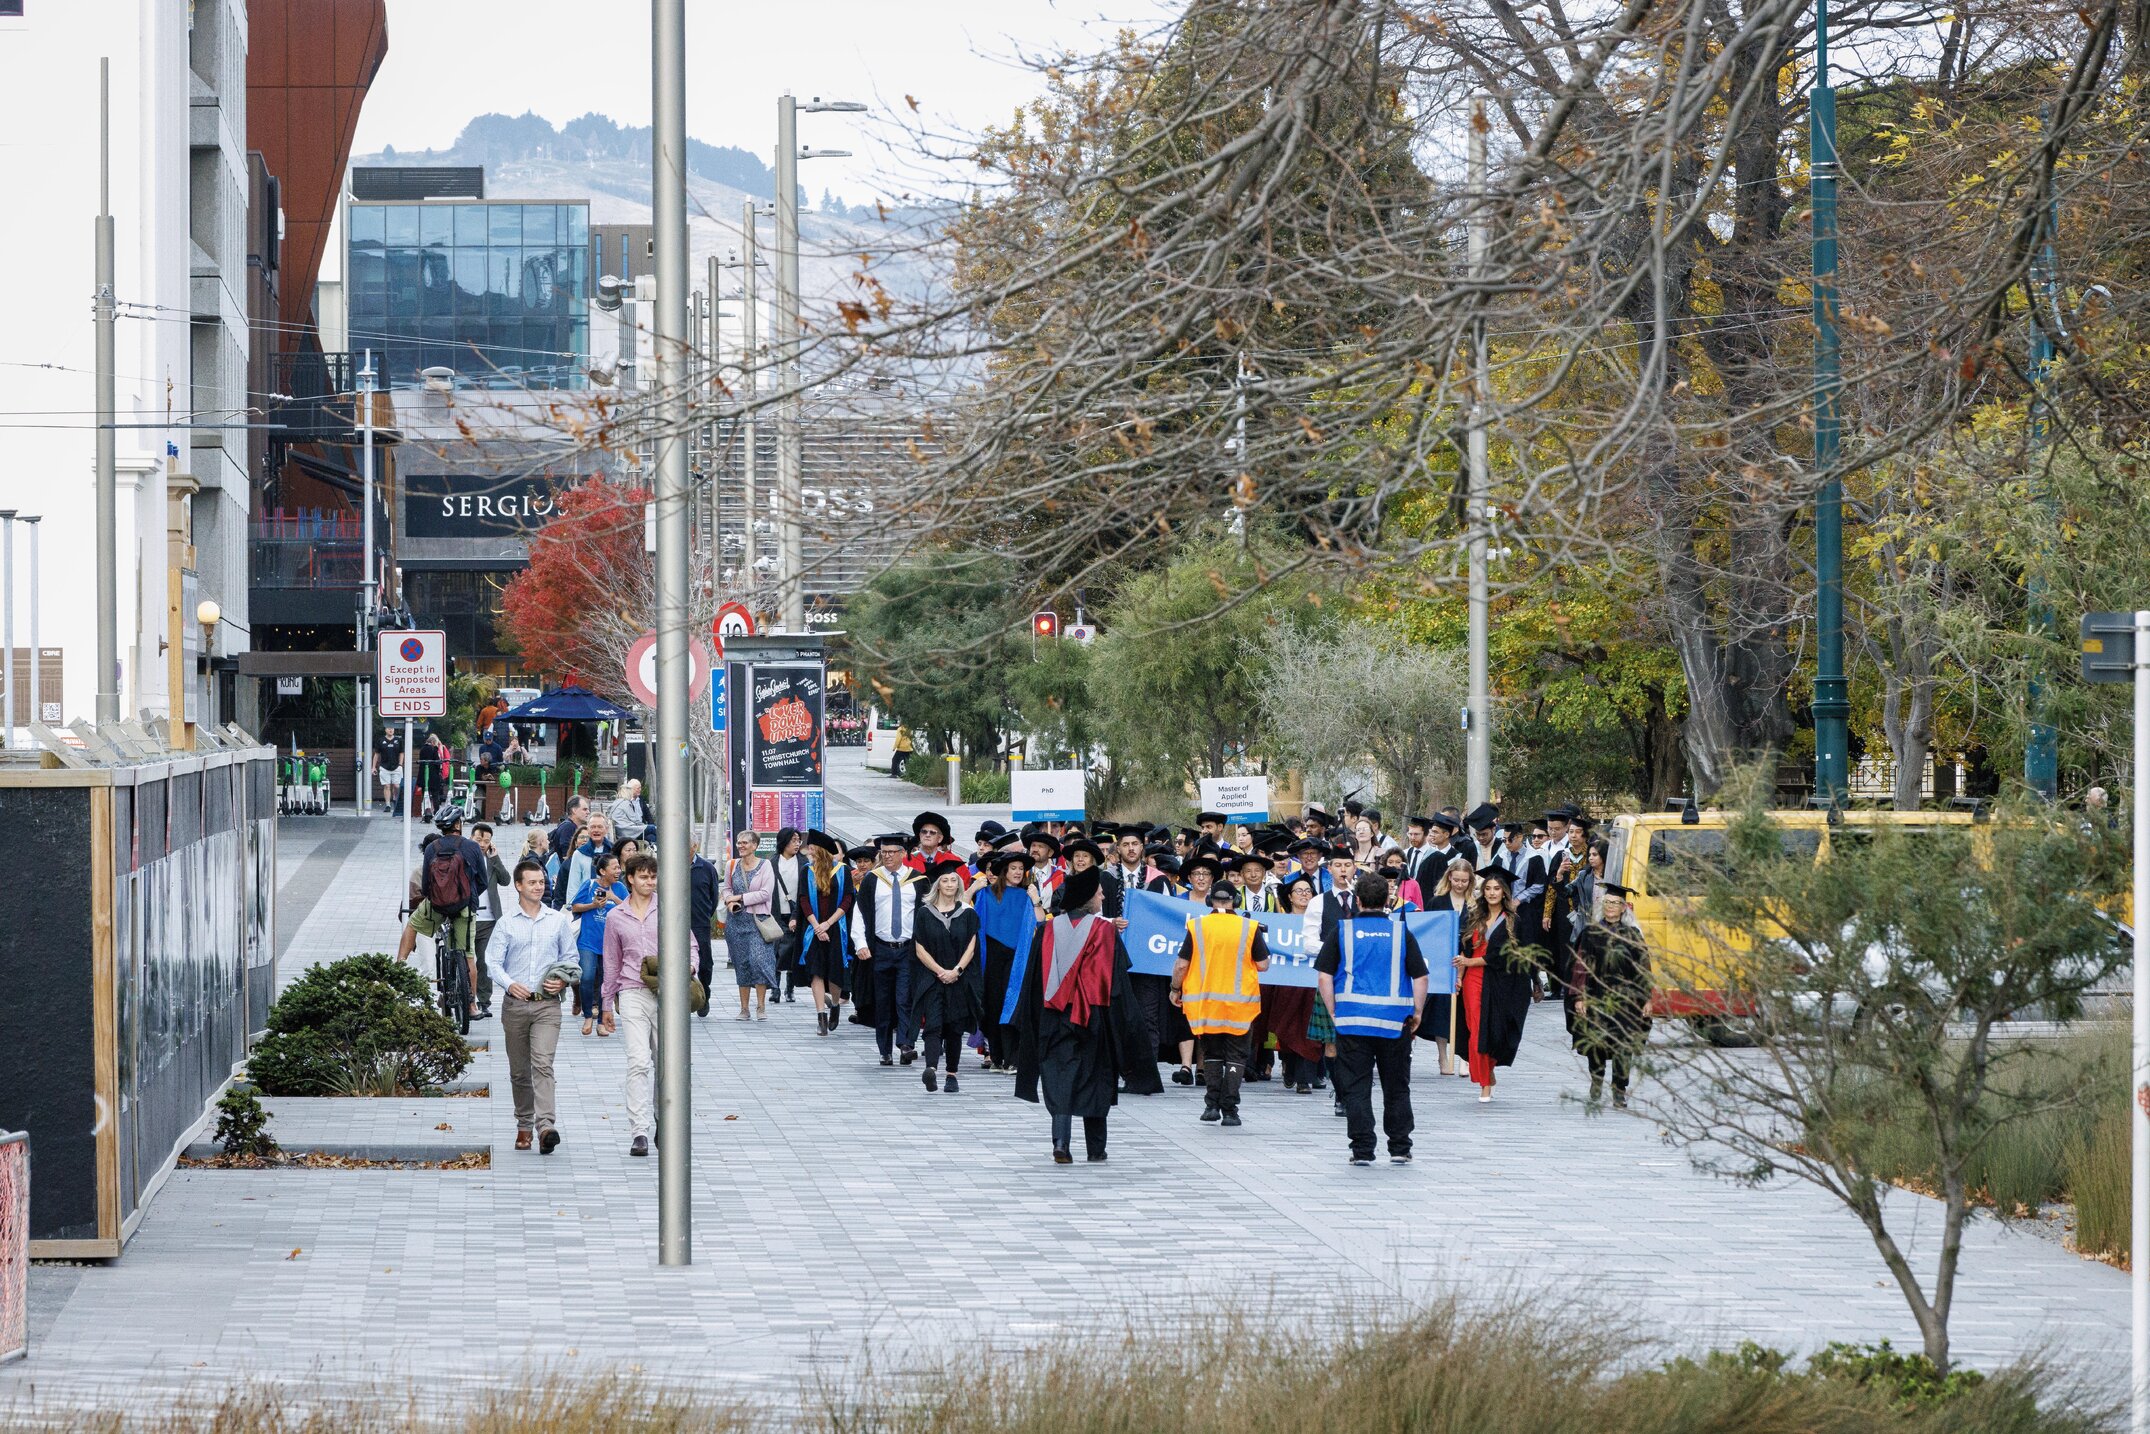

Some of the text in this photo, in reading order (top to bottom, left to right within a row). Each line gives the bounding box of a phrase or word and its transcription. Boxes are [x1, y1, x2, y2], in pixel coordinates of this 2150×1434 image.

[805, 613, 838, 623] BOSS
[390, 665, 435, 675] Except in
[384, 675, 440, 685] Signposted
[398, 685, 427, 694] Areas
[394, 701, 431, 711] ENDS
[770, 711, 805, 732] DOWN
[762, 748, 776, 757] 11.07
[762, 748, 810, 763] CHRISTCHURCH
[764, 757, 801, 770] TOWN HALL
[1215, 800, 1254, 808] Computing
